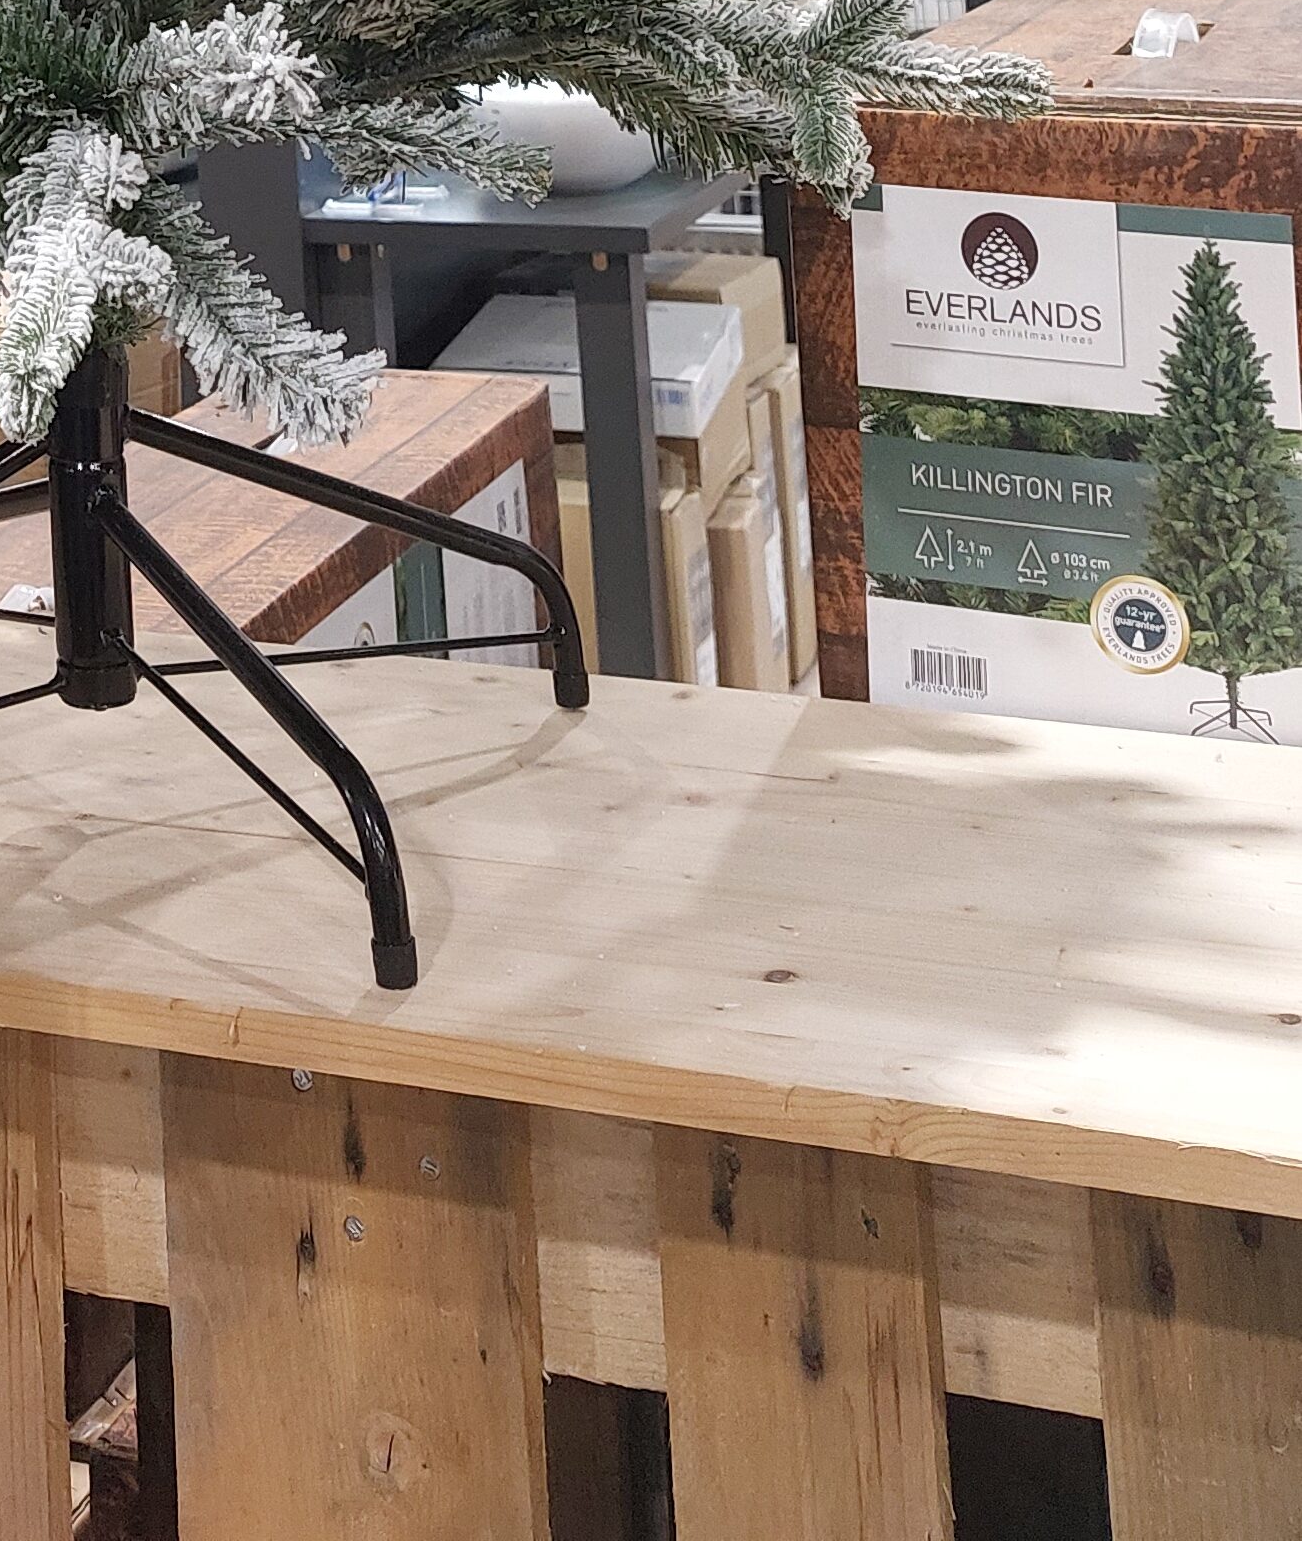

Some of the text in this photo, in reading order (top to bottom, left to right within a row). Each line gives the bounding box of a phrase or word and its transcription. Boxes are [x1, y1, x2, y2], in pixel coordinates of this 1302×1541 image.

[906, 288, 1102, 333] EVERLANDS
[915, 320, 1094, 346] everlasting christmas trees
[910, 462, 1114, 509] KILLINGTON FIR
[956, 539, 993, 557] 2.1 m
[1062, 552, 1088, 568] 103
[1089, 557, 1111, 571] cm
[1103, 587, 1177, 627] QUALITY APPROVED
[1125, 604, 1158, 622] 12-yr
[1102, 627, 1176, 665] EVERLANDS TREES
